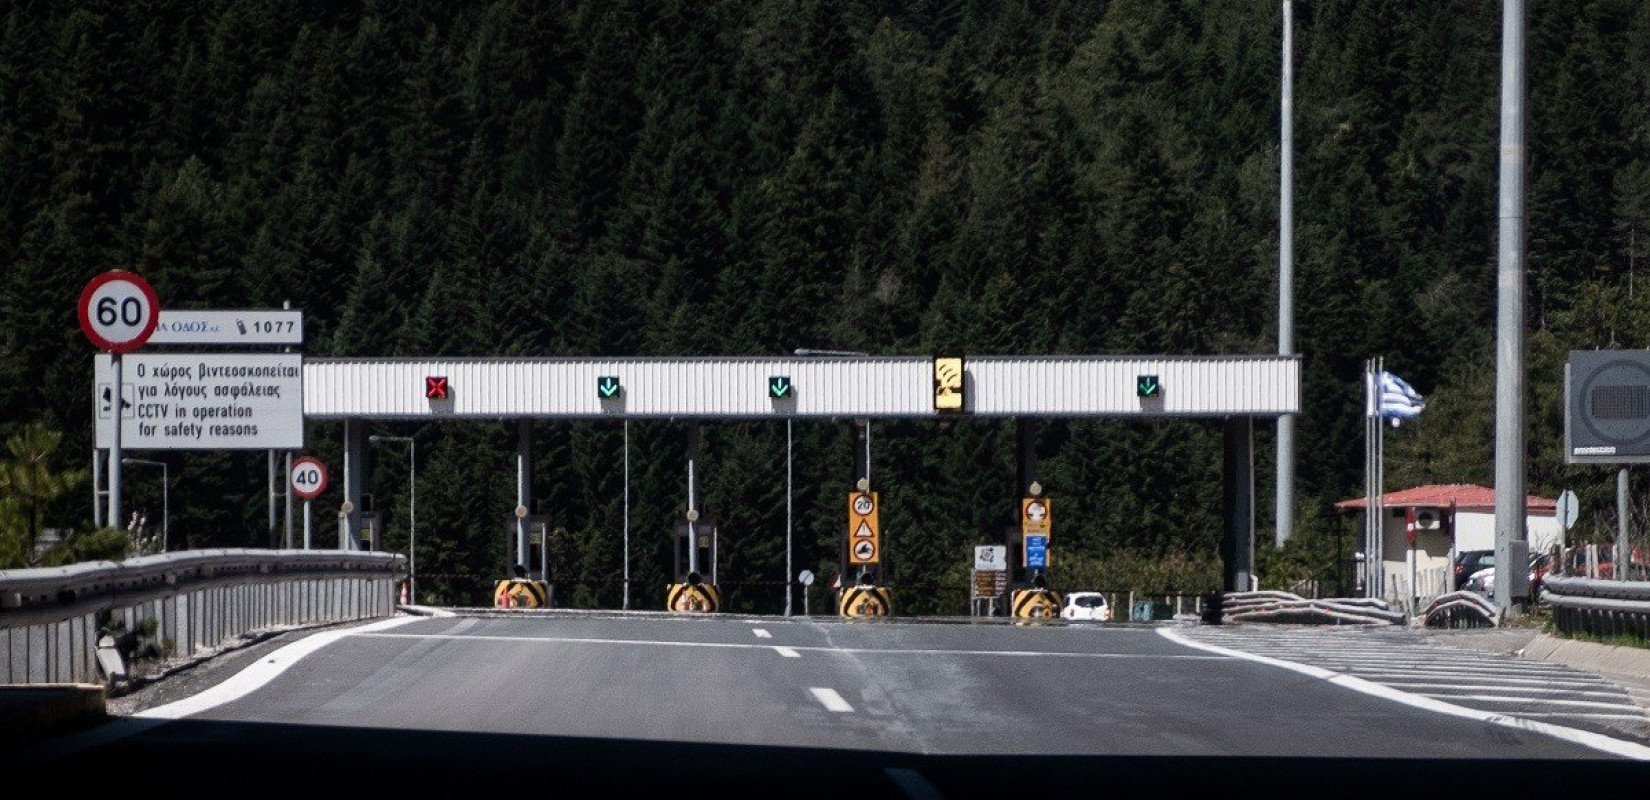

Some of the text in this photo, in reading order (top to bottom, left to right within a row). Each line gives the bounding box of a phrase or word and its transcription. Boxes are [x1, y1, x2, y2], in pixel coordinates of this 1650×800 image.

[97, 297, 141, 326] 60
[172, 321, 209, 332] ΟΔΟΣ
[254, 321, 294, 333] 1077
[152, 363, 192, 380] χώρος
[138, 382, 281, 400] για λόγους ασφάλειας
[138, 404, 253, 422] CCTV in operation
[139, 423, 258, 439] for safety reasons
[296, 470, 318, 484] 40
[857, 501, 870, 509] 20
